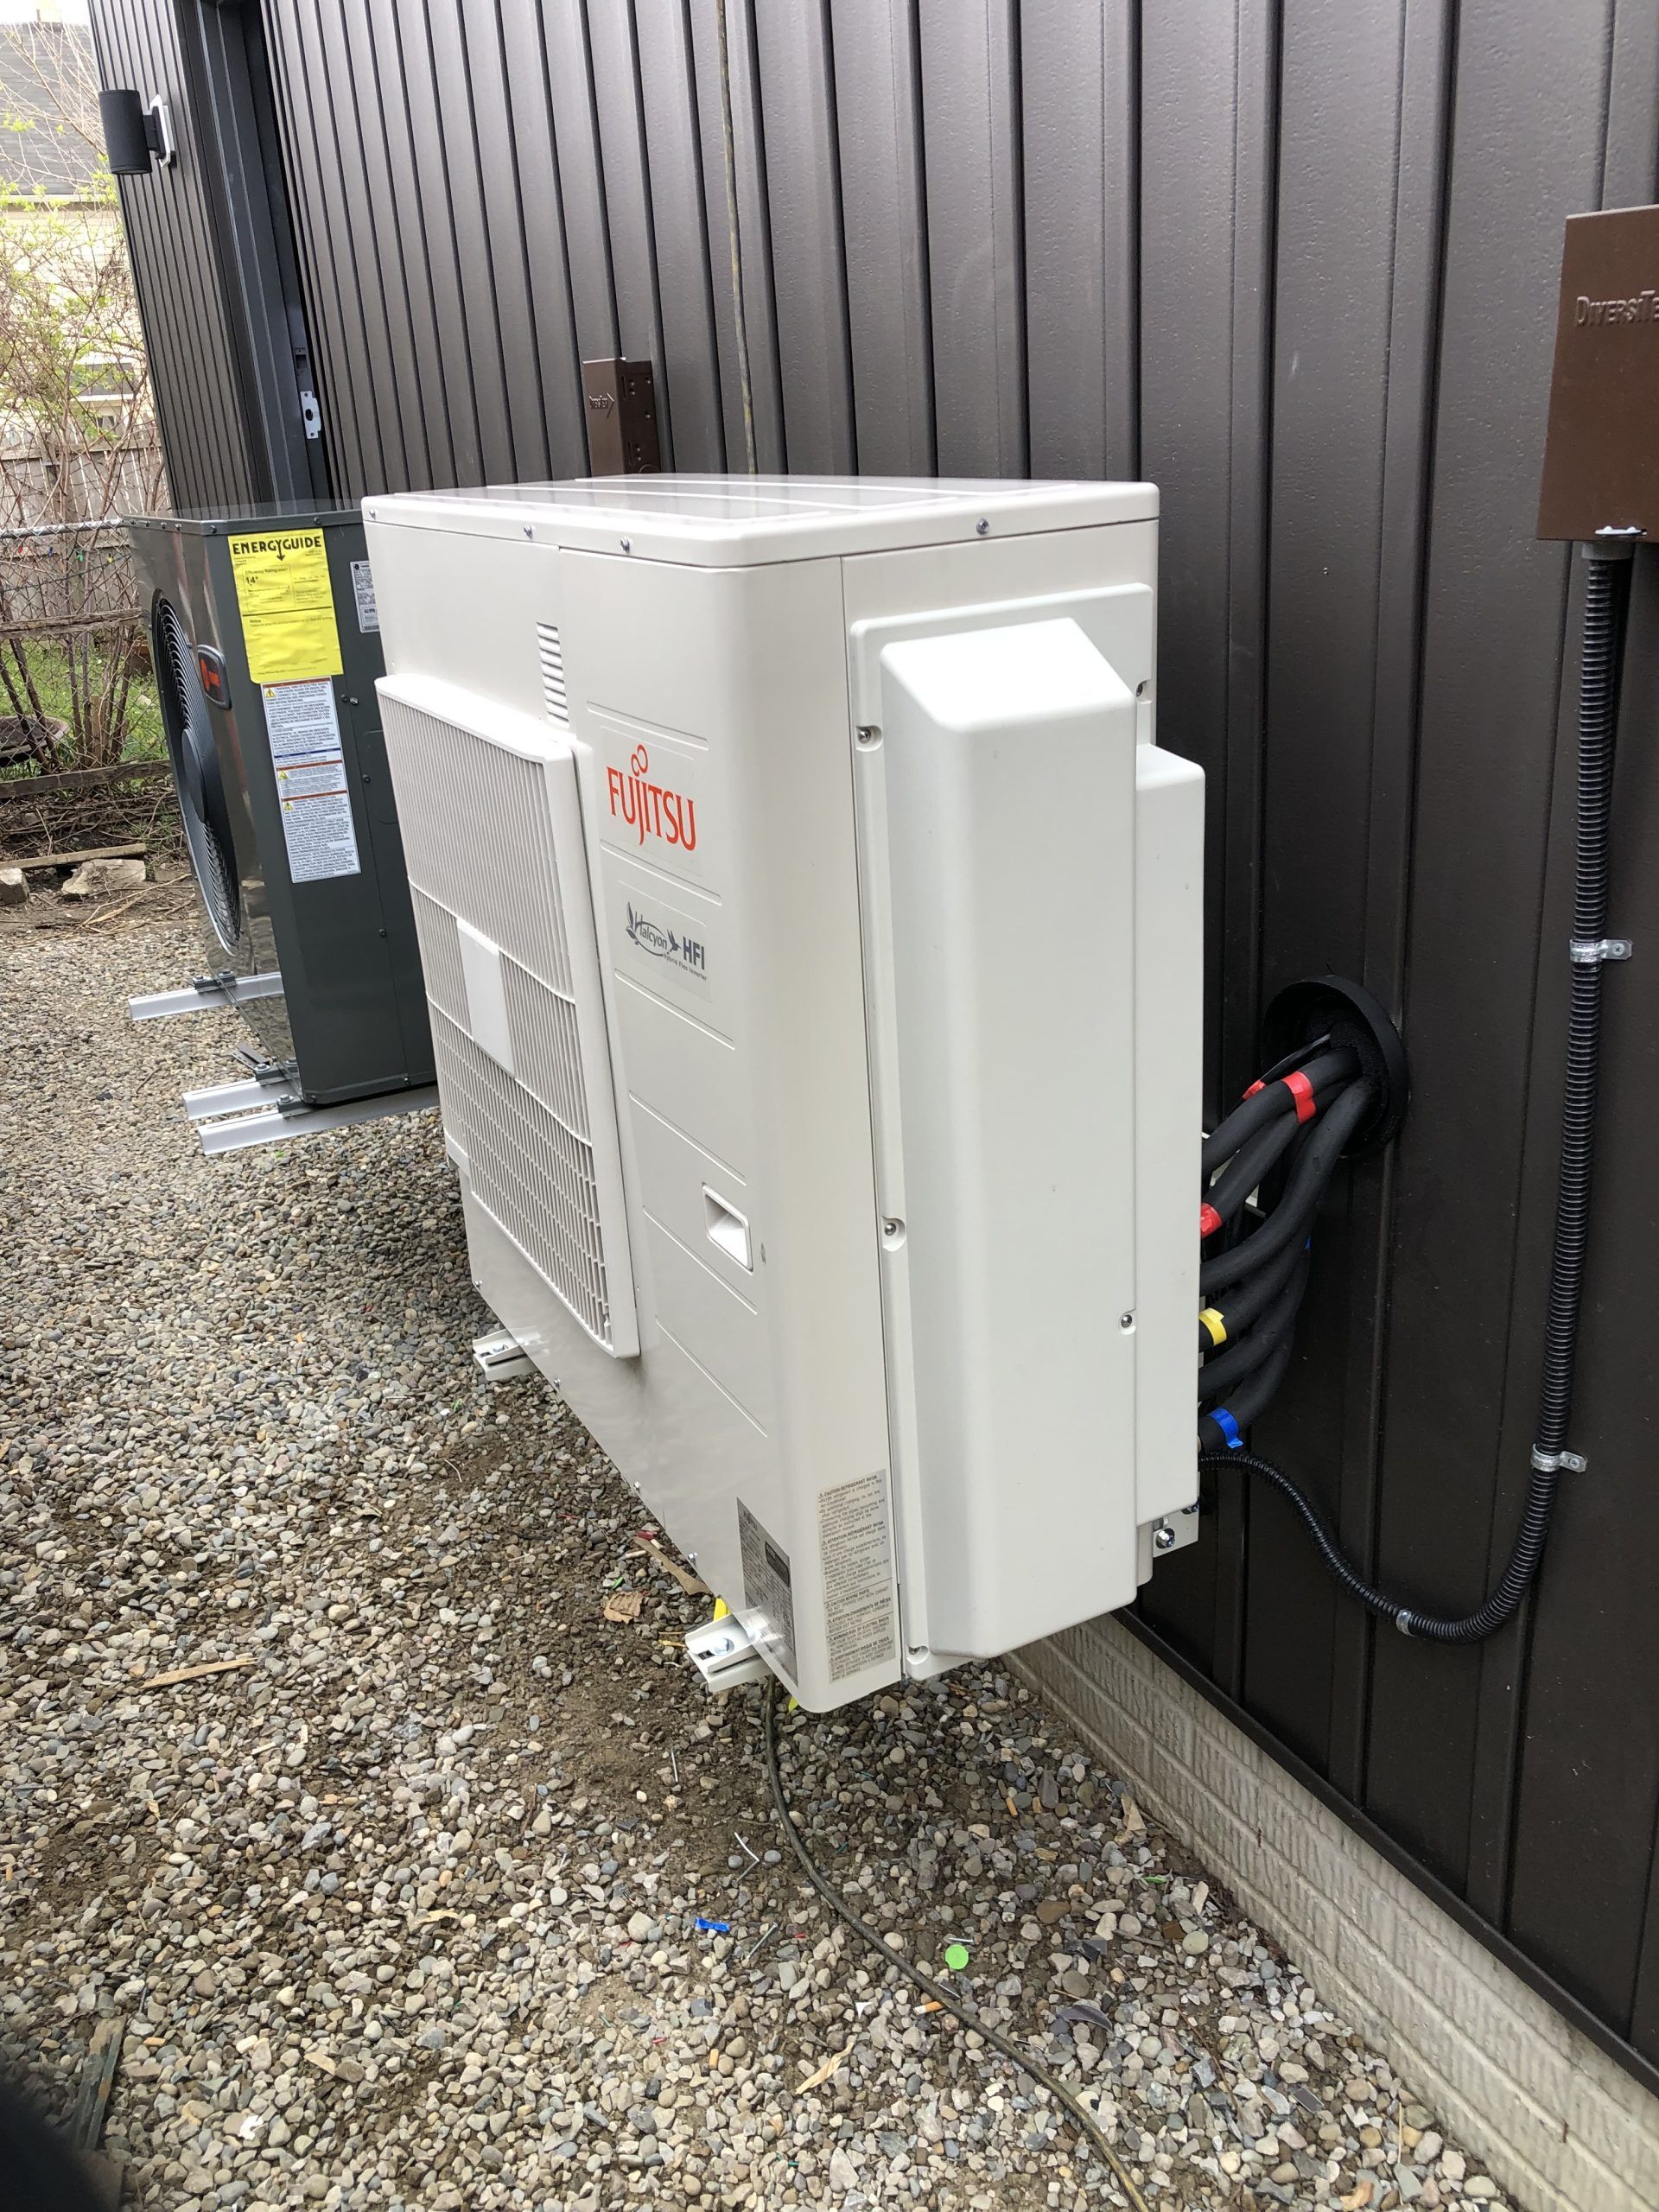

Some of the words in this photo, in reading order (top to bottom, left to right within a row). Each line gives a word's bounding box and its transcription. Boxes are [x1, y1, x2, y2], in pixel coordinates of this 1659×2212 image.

[232, 536, 322, 556] ENERGYGUIDE
[607, 766, 696, 851] FUJITSU
[634, 910, 668, 950] Halcyon
[683, 936, 705, 970] HFI
[678, 961, 689, 971] Flex
[689, 967, 707, 982] Inverter
